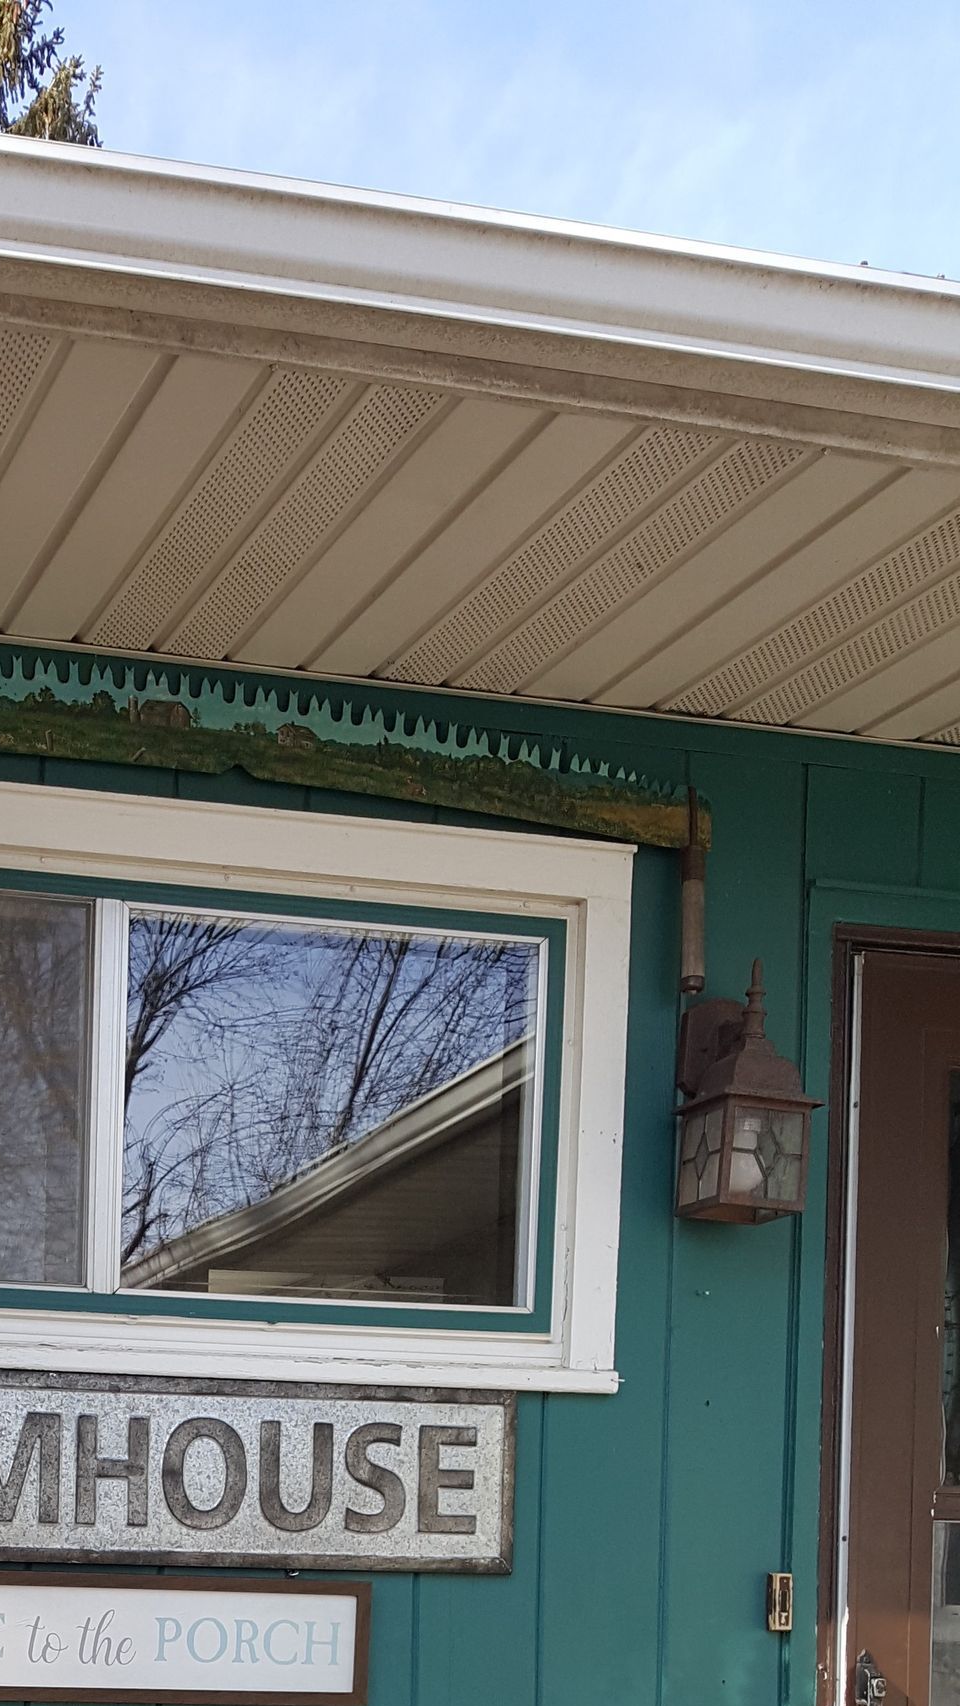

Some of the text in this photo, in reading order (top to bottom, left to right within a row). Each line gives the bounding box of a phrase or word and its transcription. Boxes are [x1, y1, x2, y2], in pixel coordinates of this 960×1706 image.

[26, 1615, 69, 1664] to
[76, 1609, 137, 1667] the
[153, 1617, 341, 1667] PORCH
